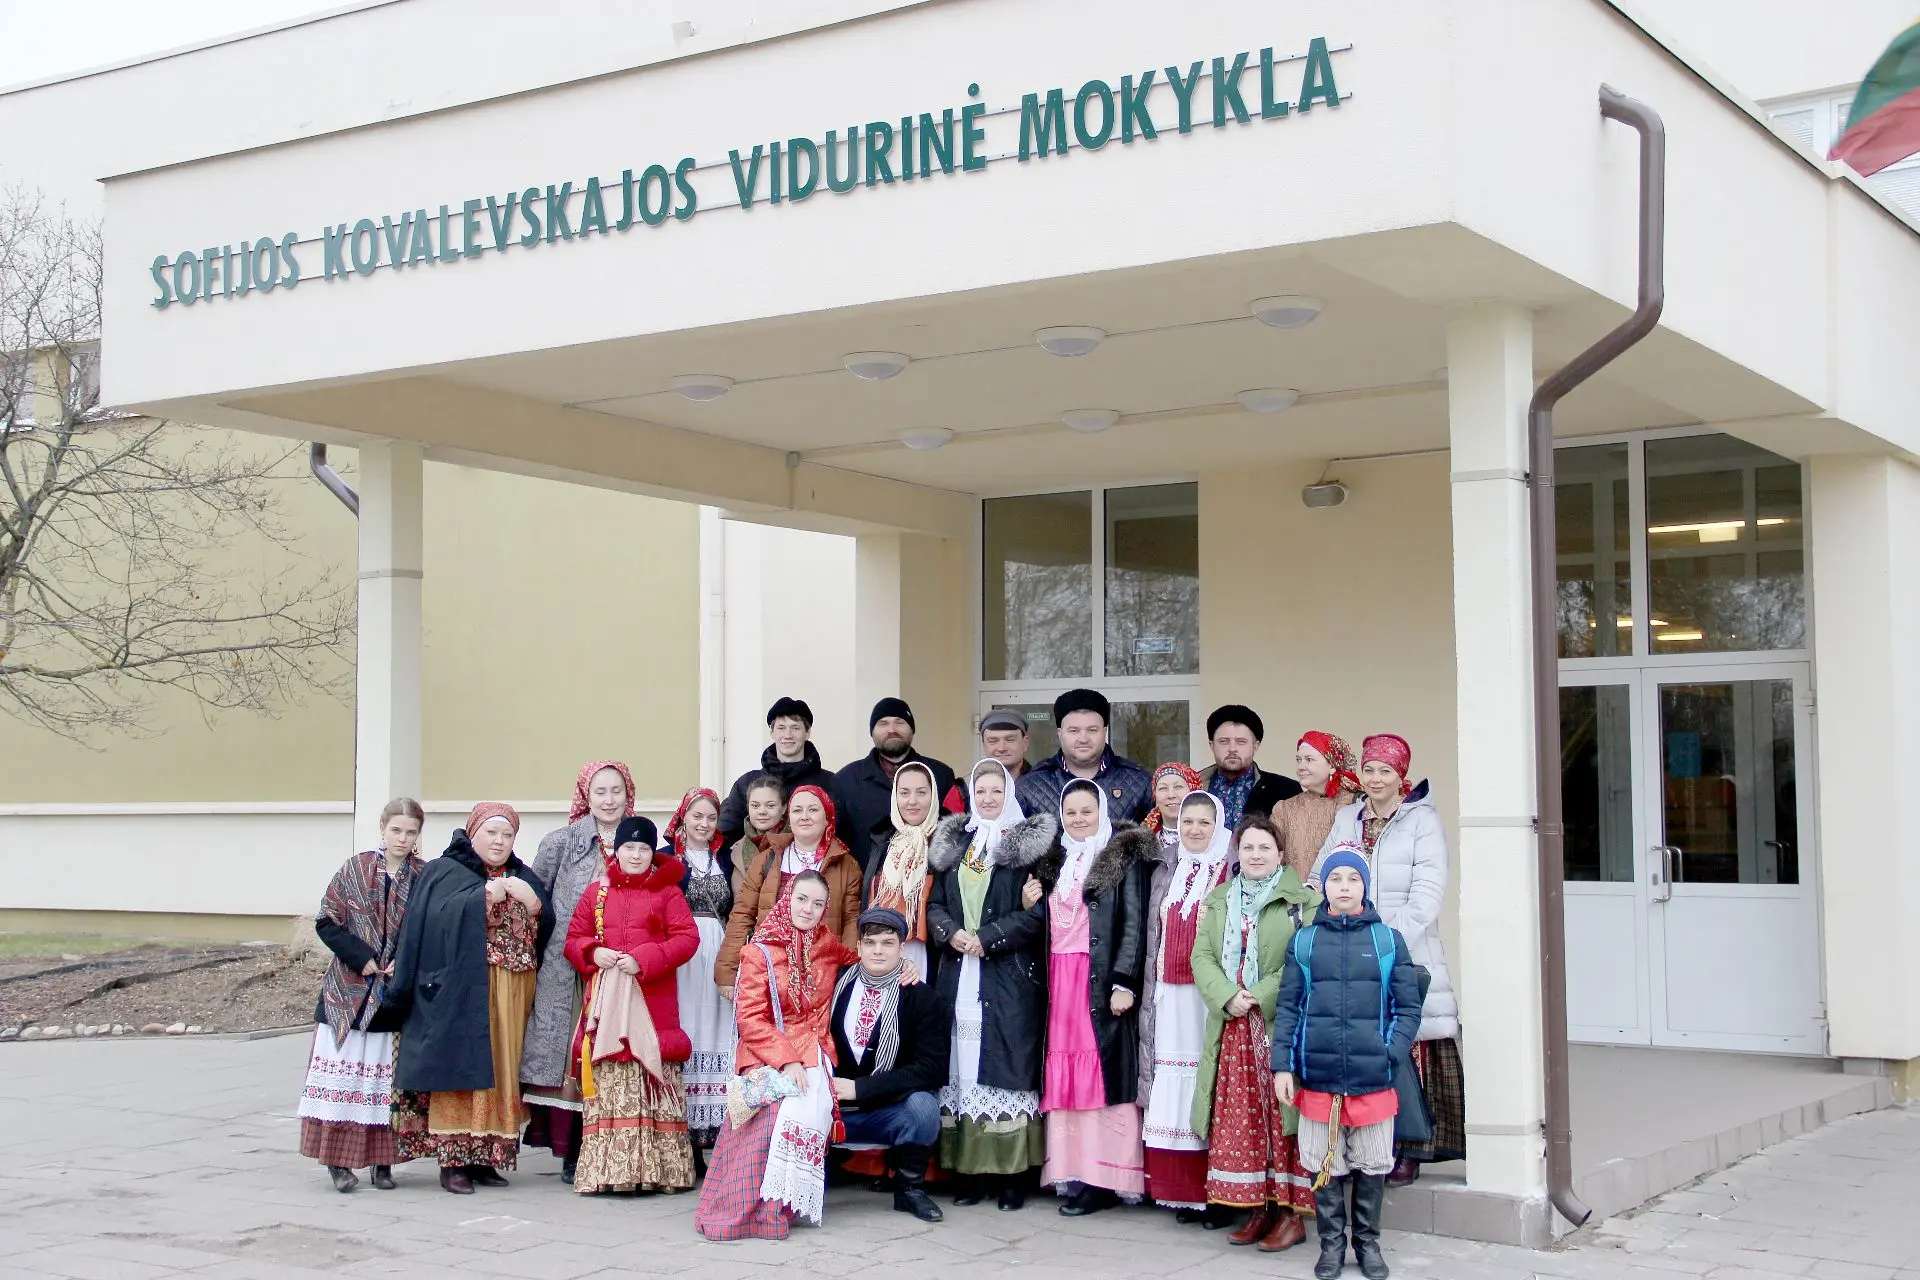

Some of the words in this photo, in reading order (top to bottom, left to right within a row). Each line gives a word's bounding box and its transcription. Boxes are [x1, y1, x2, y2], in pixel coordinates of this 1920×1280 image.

[153, 236, 298, 309] SOFIJOS
[324, 157, 698, 281] KOVALEVSKAJOS
[729, 83, 987, 210] VIDURINĖ
[1018, 37, 1340, 162] MOKYKLA
